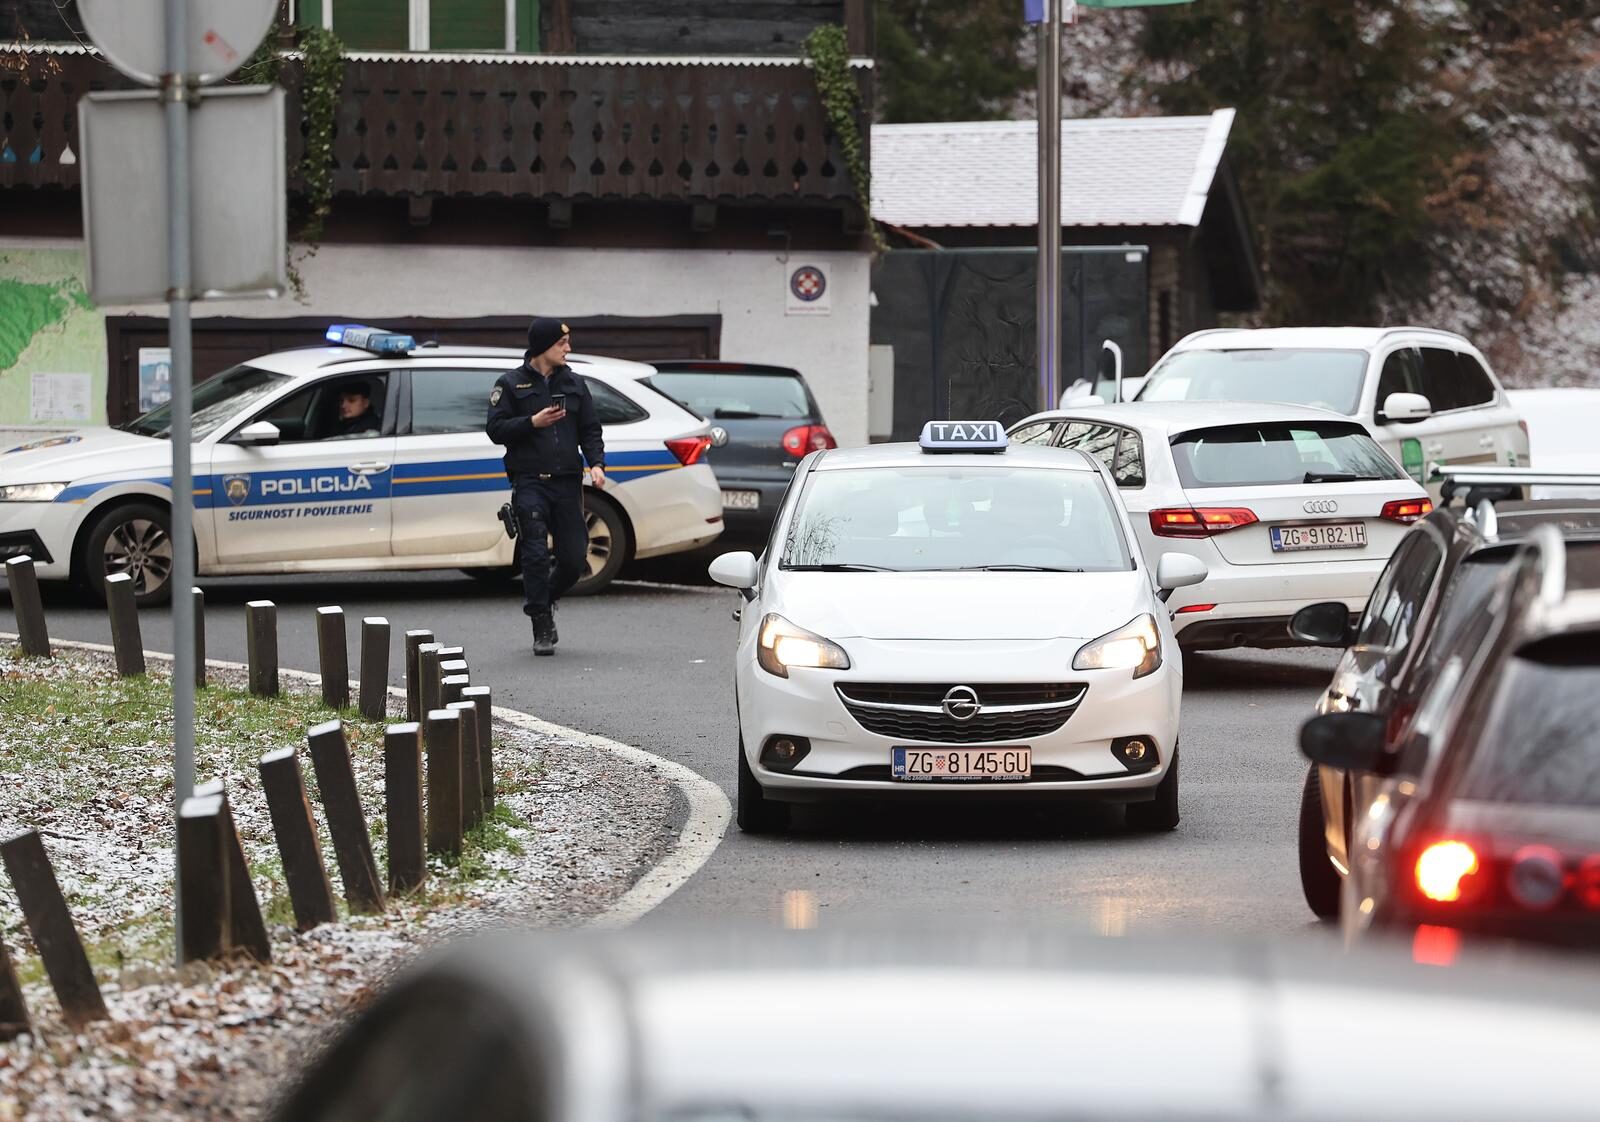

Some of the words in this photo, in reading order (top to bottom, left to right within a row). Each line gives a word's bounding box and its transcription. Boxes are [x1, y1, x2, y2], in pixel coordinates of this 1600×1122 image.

[933, 424, 995, 440] TAXI
[261, 475, 372, 496] POLICIJA
[229, 508, 295, 521] SIGURNOST
[296, 508, 301, 518] I
[304, 504, 373, 517] POVJERENJE
[1282, 529, 1301, 546] ZG
[908, 752, 933, 773] ZG
